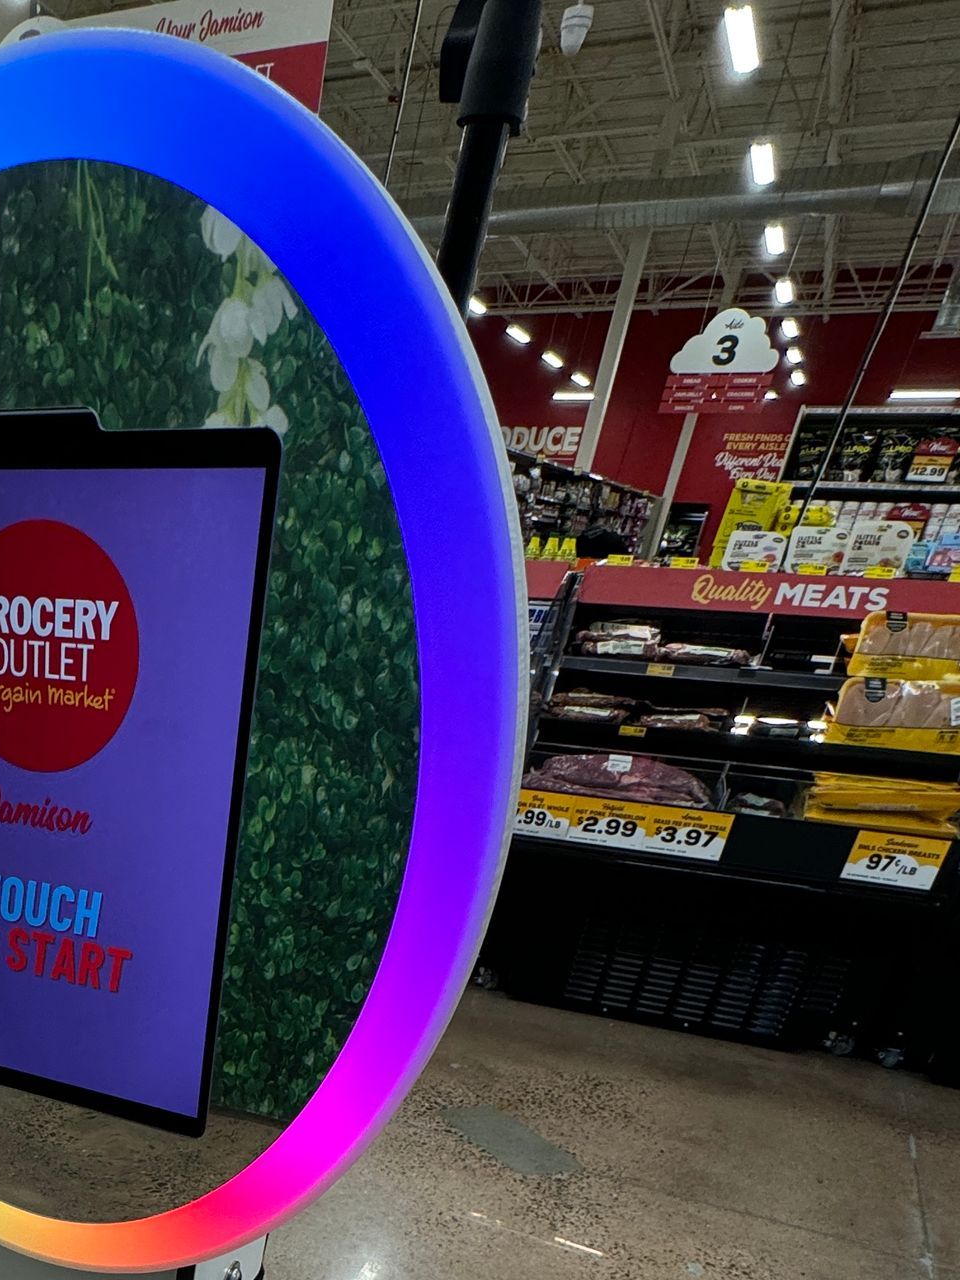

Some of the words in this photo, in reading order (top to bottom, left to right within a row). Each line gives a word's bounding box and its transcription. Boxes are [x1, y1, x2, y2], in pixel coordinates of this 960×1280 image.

[198, 9, 264, 42] Jamison
[711, 334, 739, 366] 3
[723, 433, 754, 442] FRESH
[755, 434, 783, 442] FINDS
[725, 442, 757, 451] EVERY
[714, 451, 762, 471] Different
[729, 467, 755, 480] Every
[691, 574, 773, 611] Quality
[773, 582, 890, 612] MEATS
[47, 684, 114, 712] market
[577, 816, 638, 839] $2.99
[655, 825, 720, 848] $3.97
[876, 846, 907, 855] CHICKEN
[907, 850, 941, 859] BREASTS
[6, 926, 134, 994] START
